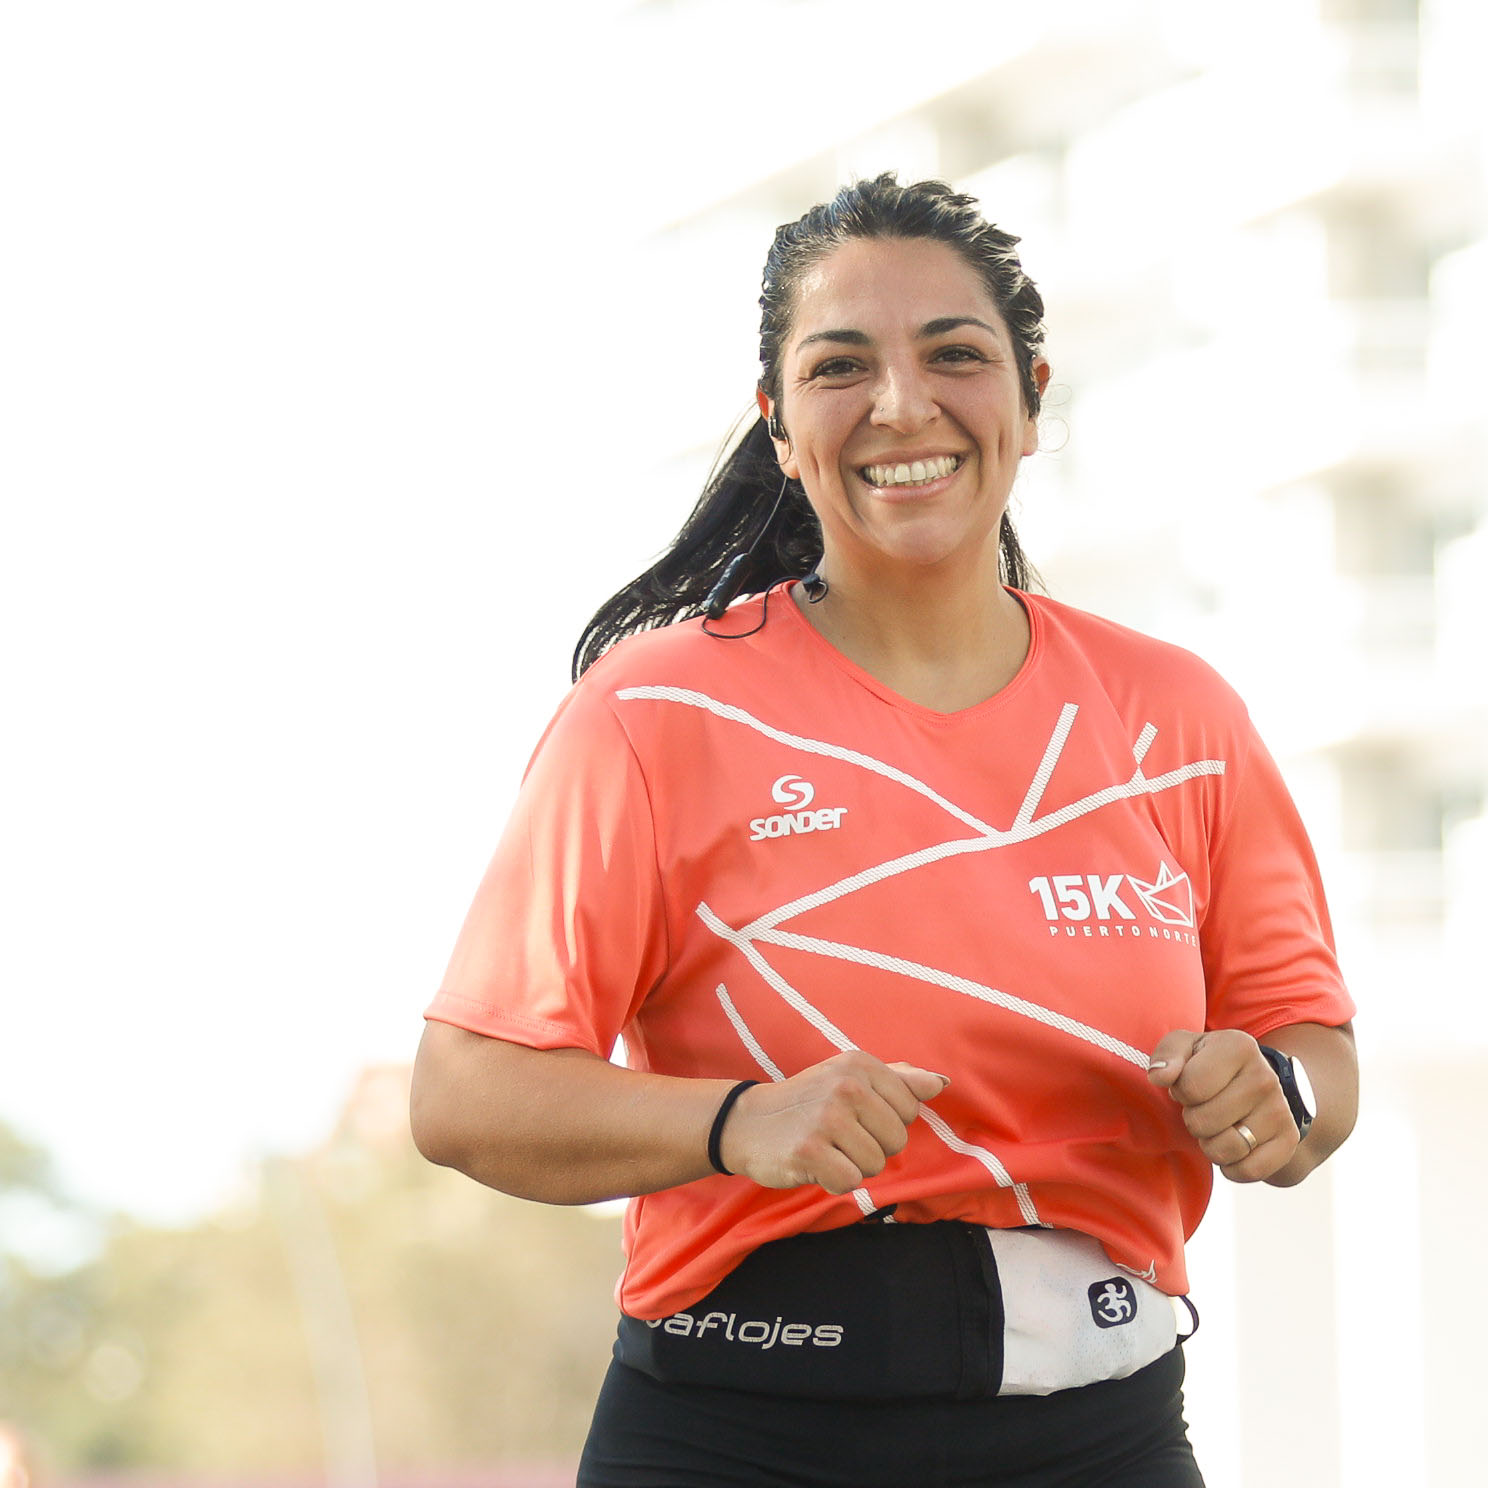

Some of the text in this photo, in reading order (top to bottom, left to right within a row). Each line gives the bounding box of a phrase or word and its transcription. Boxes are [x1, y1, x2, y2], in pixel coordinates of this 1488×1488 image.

[1029, 874, 1136, 921] 15K
[1049, 925, 1197, 947] PUERTO NORTE
